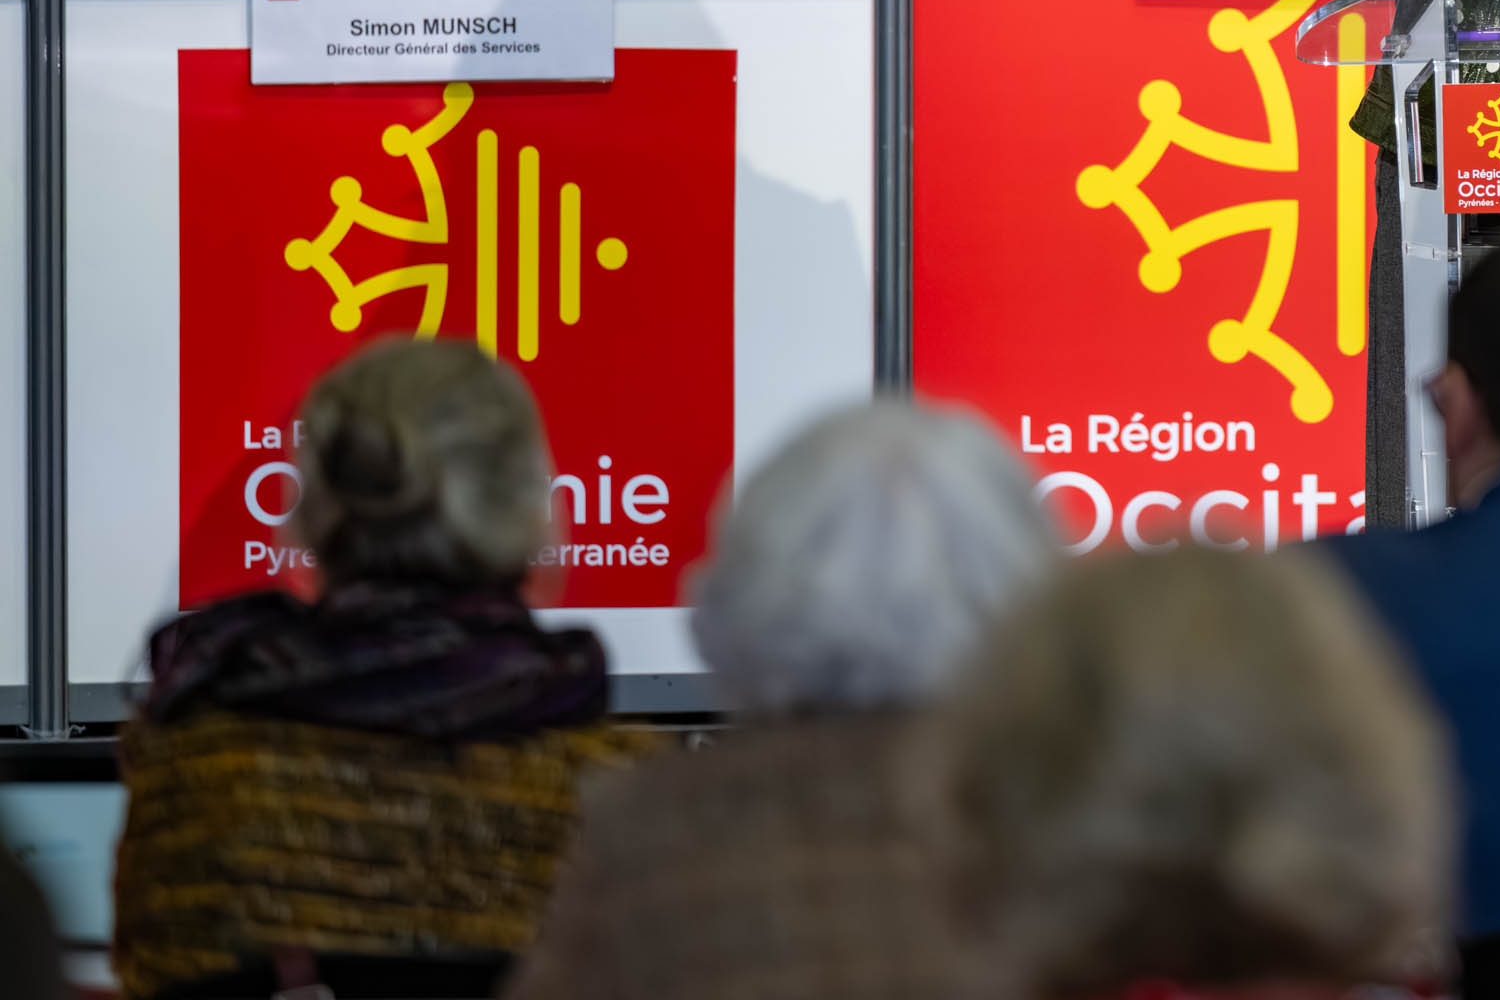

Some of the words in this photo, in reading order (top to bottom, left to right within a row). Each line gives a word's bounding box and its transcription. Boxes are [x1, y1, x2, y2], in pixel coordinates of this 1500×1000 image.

[350, 19, 415, 36] Simon
[423, 17, 517, 35] MUNSCH
[326, 43, 390, 57] Directeur
[395, 42, 448, 56] Général
[453, 42, 477, 55] des
[482, 41, 540, 55] Services
[1458, 170, 1470, 179] La
[1458, 199, 1494, 208] Pyrénées
[244, 420, 282, 449] La
[1021, 415, 1072, 453] La
[1088, 411, 1256, 462] Région
[1031, 462, 1365, 557] Occit
